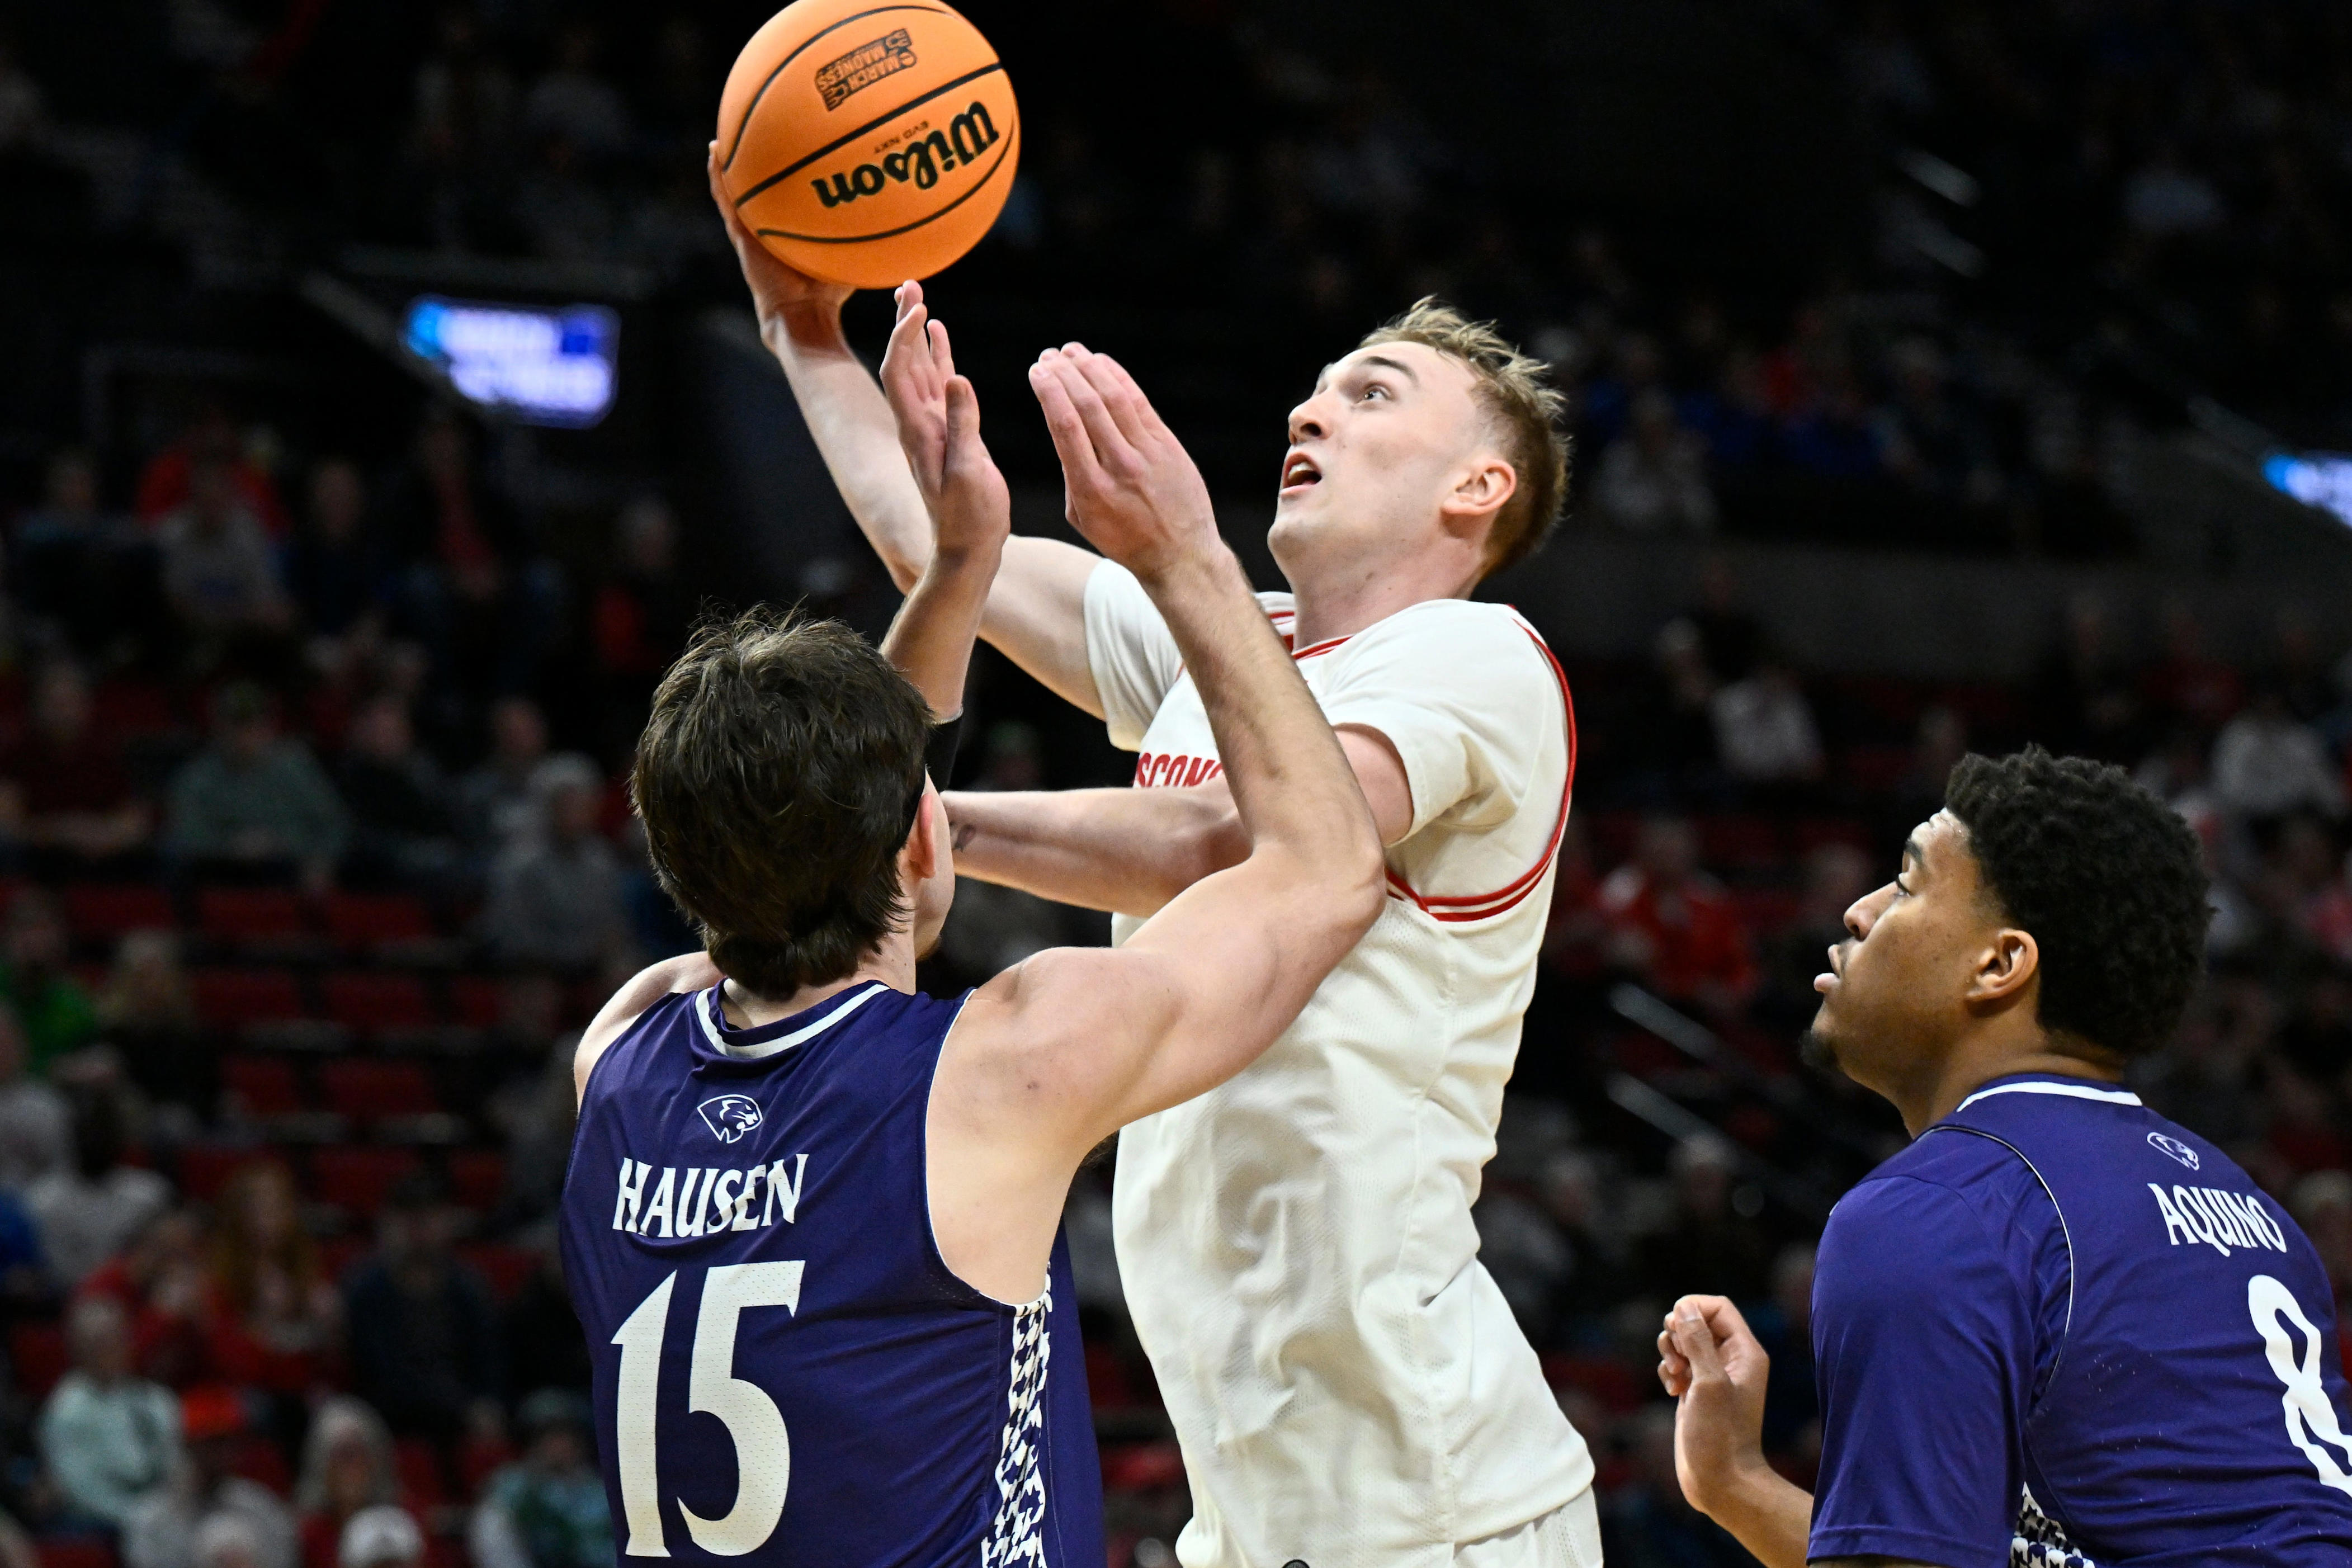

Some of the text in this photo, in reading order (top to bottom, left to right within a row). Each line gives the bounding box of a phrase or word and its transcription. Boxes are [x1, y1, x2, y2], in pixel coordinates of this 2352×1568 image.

[817, 45, 886, 91] MADNESS
[847, 55, 901, 91] MARCH
[811, 101, 999, 208] Wilson
[1136, 752, 1224, 788] SCON
[612, 1154, 809, 1238] HAUSEN
[2147, 1183, 2287, 1257] AQUINO
[611, 1260, 806, 1557] 15
[2248, 1274, 2352, 1499] 8
